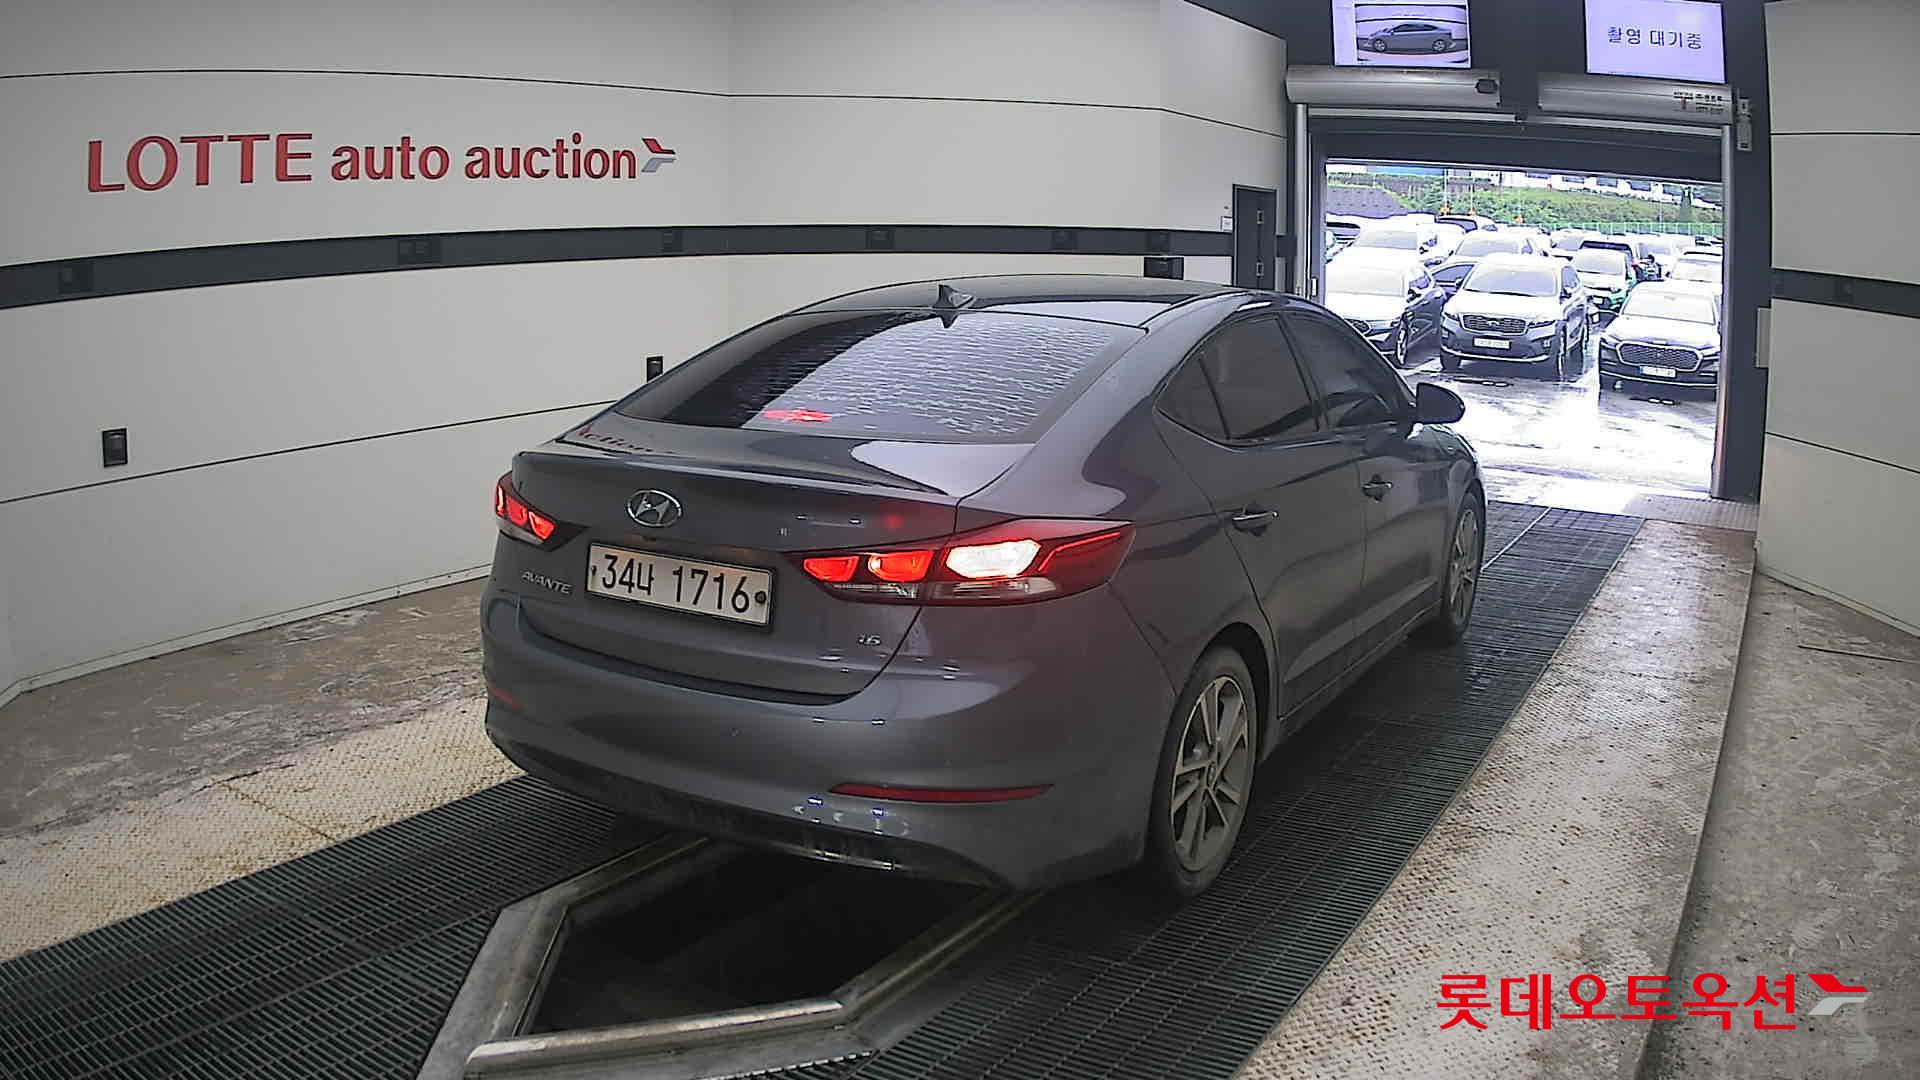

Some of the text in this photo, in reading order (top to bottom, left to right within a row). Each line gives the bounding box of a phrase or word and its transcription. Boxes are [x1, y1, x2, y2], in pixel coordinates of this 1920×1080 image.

[1607, 26, 1702, 49] 촬영 대기중
[88, 133, 637, 192] LOTTE auto auction
[521, 571, 573, 594] AVANTE
[601, 553, 750, 613] 34나 1716
